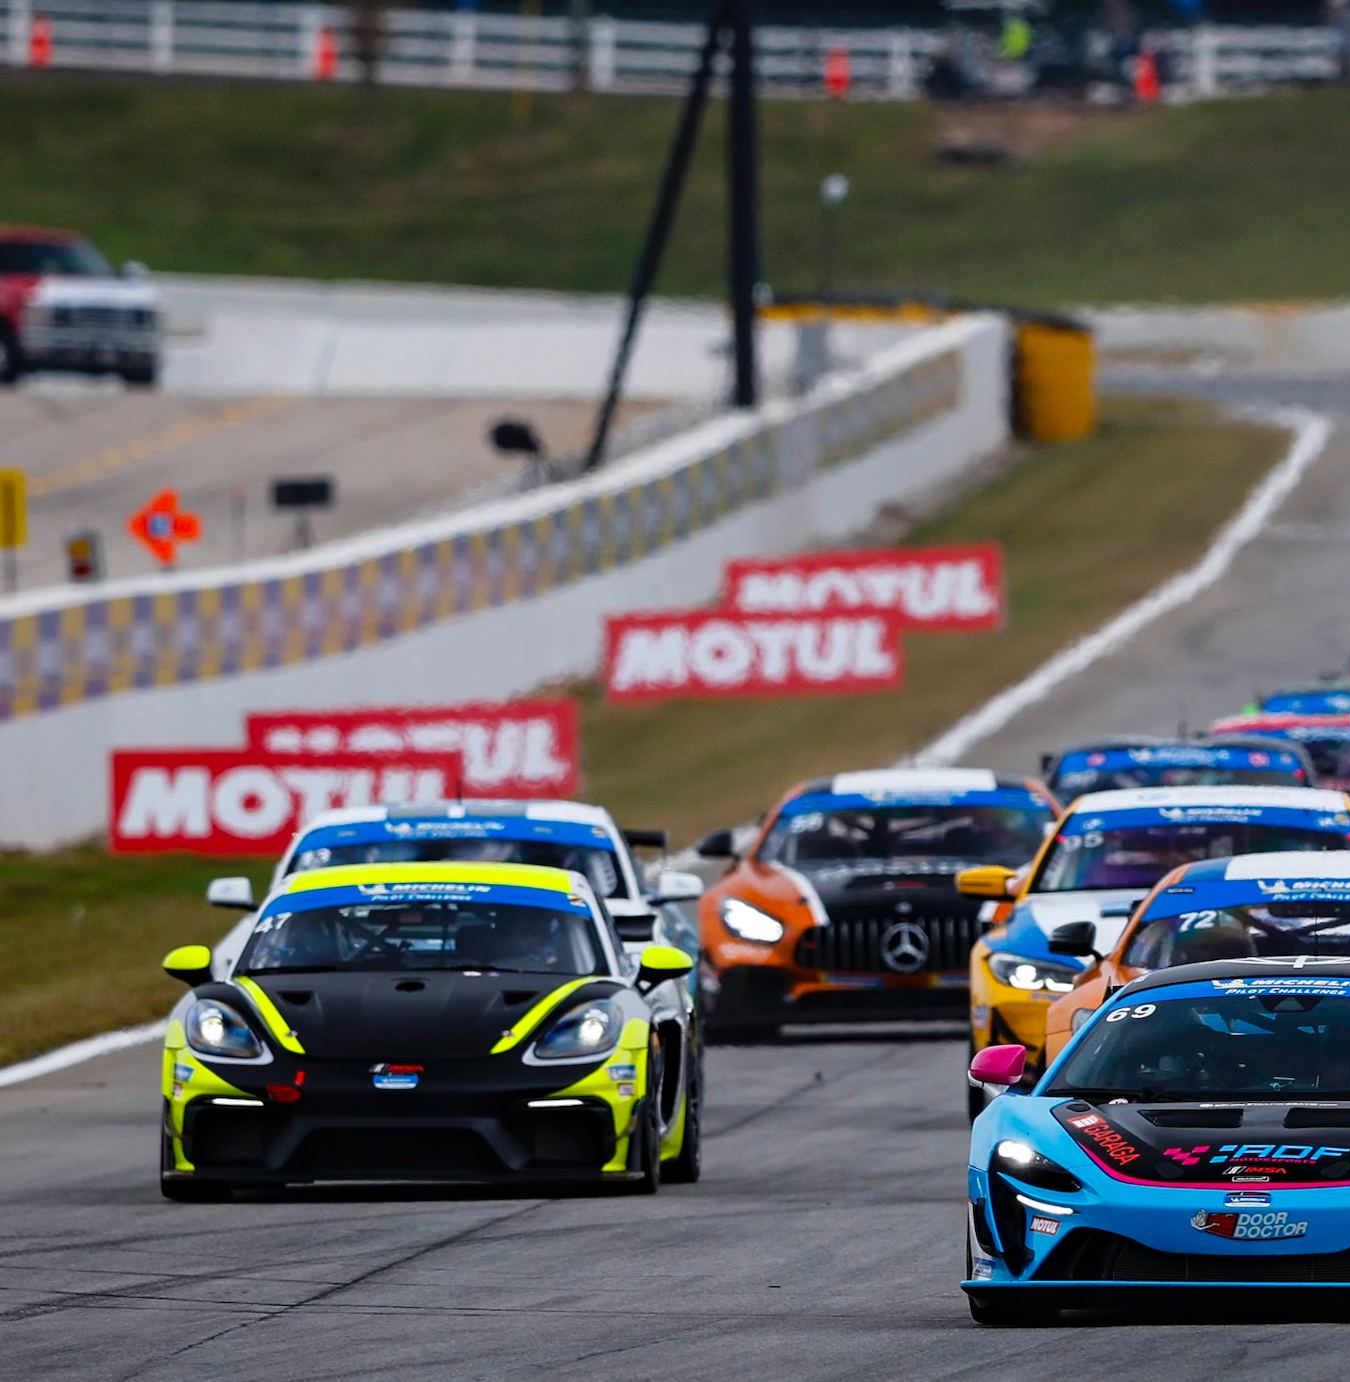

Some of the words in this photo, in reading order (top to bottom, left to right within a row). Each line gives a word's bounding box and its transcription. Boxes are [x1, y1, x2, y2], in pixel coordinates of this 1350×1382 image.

[608, 617, 896, 692] MOTUL
[254, 911, 293, 934] 47
[1179, 909, 1217, 932] 72
[1225, 987, 1263, 995] PILOT
[1269, 987, 1348, 996] CHALLENGE
[1105, 1003, 1157, 1022] 69
[1083, 1123, 1141, 1166] GARAGA
[1244, 1166, 1288, 1174] IMSA
[1030, 1217, 1060, 1235] MOTUL
[1237, 1211, 1288, 1226] DOOR
[1232, 1221, 1309, 1238] DOCTOR
